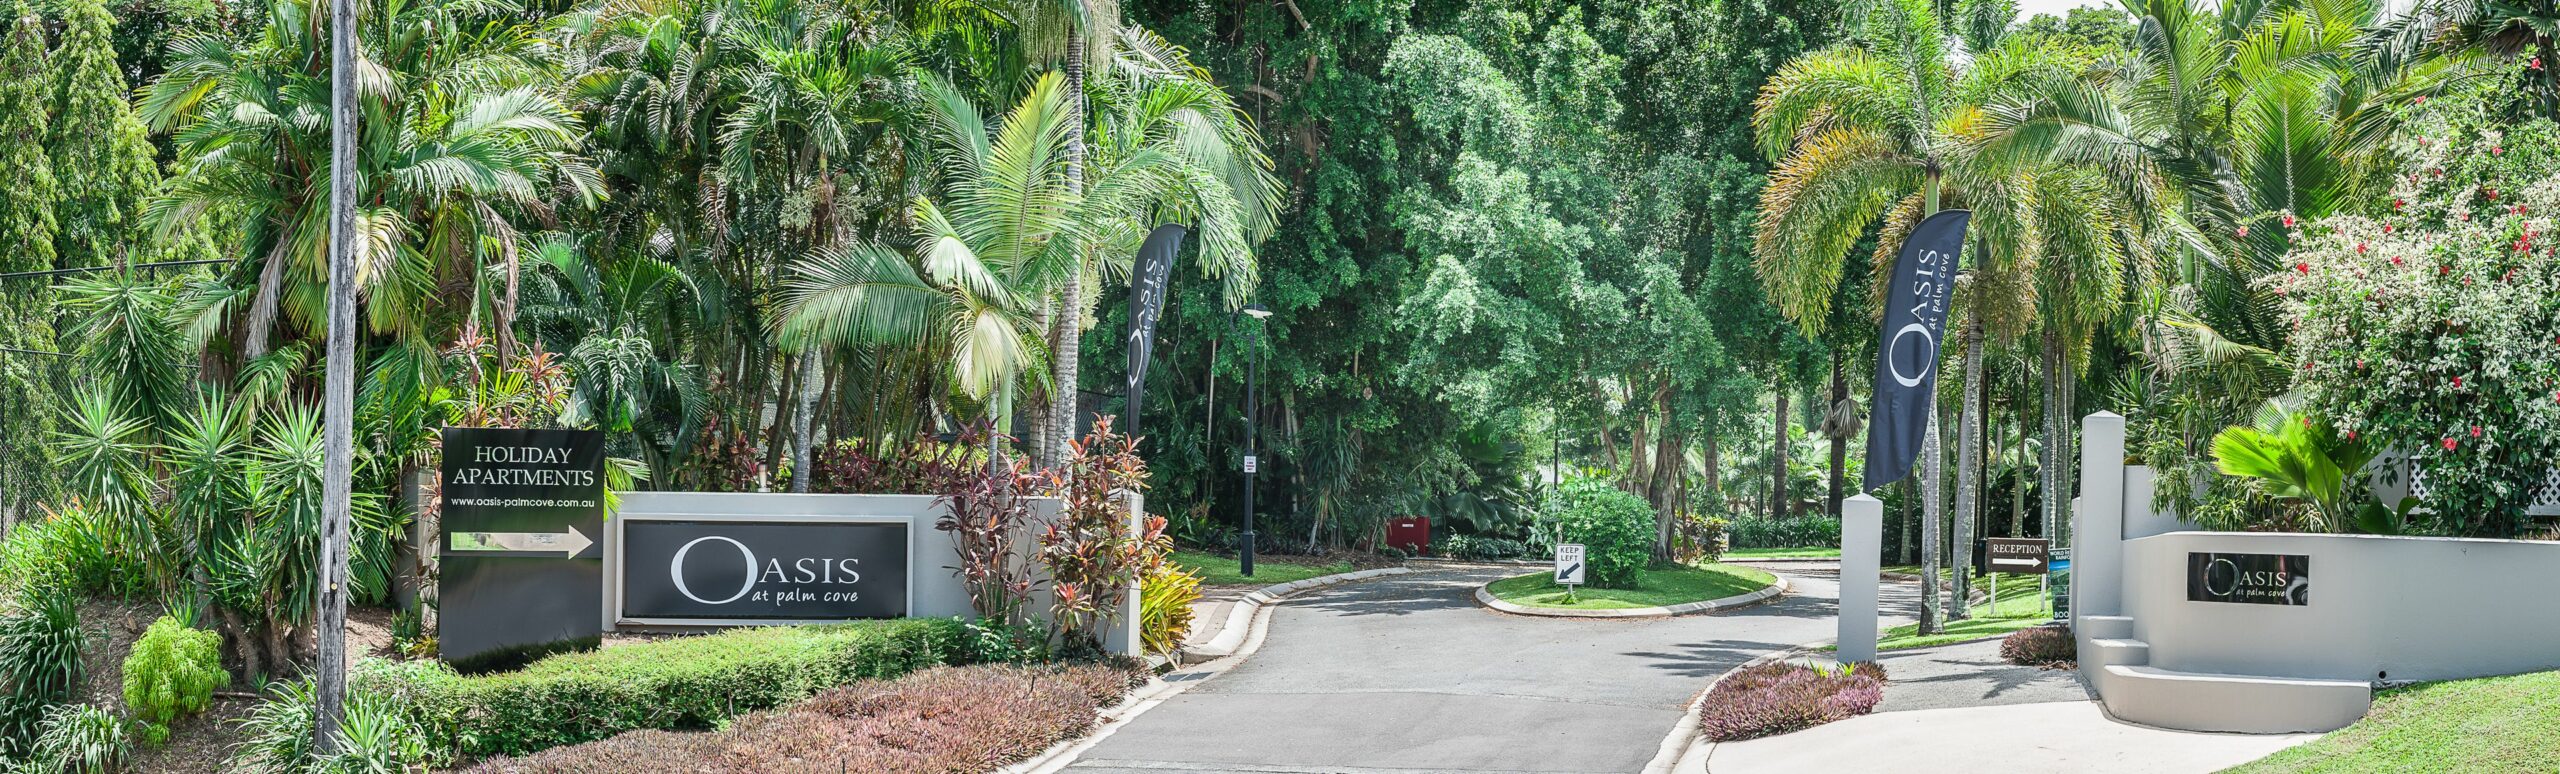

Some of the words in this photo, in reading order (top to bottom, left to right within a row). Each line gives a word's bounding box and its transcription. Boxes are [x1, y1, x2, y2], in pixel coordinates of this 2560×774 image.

[1939, 253, 1950, 279] cove
[1155, 264, 1164, 289] cove
[1932, 283, 1943, 313] palm
[1889, 249, 1938, 388] OASIS
[1929, 317, 1938, 330] at
[475, 446, 572, 464] HOLIDAY
[452, 468, 594, 487] APARTMENTS
[451, 497, 595, 508] www.oasis-palmcove.com.au
[1992, 544, 2043, 554] RECEPTION
[670, 535, 860, 605] OASIS
[2203, 558, 2287, 596] OASIS
[752, 591, 769, 602] at
[776, 588, 816, 606] palm
[823, 592, 859, 602] cove
[2236, 588, 2244, 596] at
[2246, 588, 2265, 598] palm
[2268, 589, 2285, 597] cove
